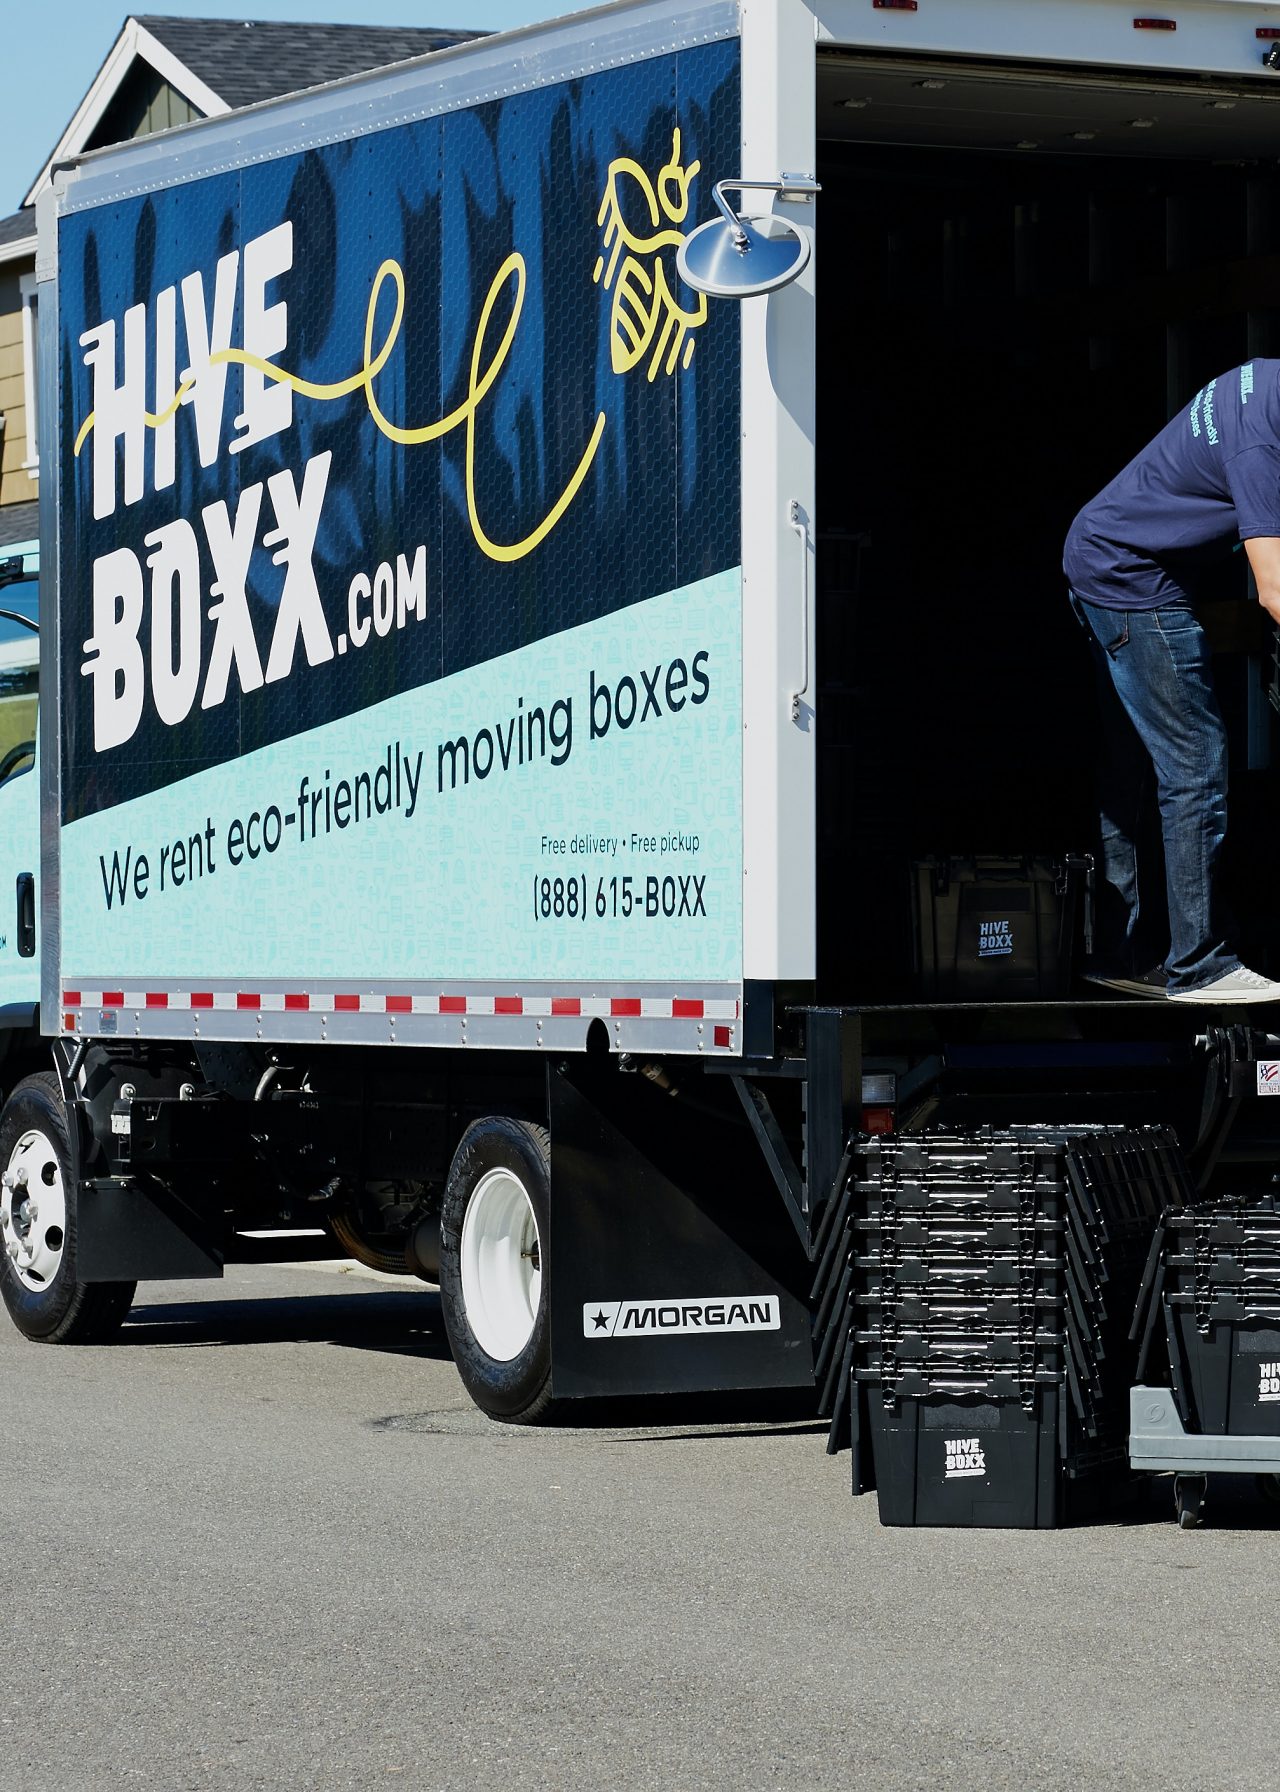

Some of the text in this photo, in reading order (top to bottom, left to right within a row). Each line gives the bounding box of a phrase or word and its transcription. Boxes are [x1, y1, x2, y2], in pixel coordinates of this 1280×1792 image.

[79, 220, 293, 520] HIVE
[100, 650, 710, 910] We rent eco-friendly moving boxes
[541, 831, 699, 857] Free delivery Free pickup
[534, 873, 707, 922] (888) 615-BOXX
[980, 921, 1009, 935] HIVE
[979, 934, 1013, 949] BOXX
[622, 1302, 771, 1329] MORGAN
[944, 1438, 980, 1455] HIVE
[945, 1453, 986, 1470] BOXX
